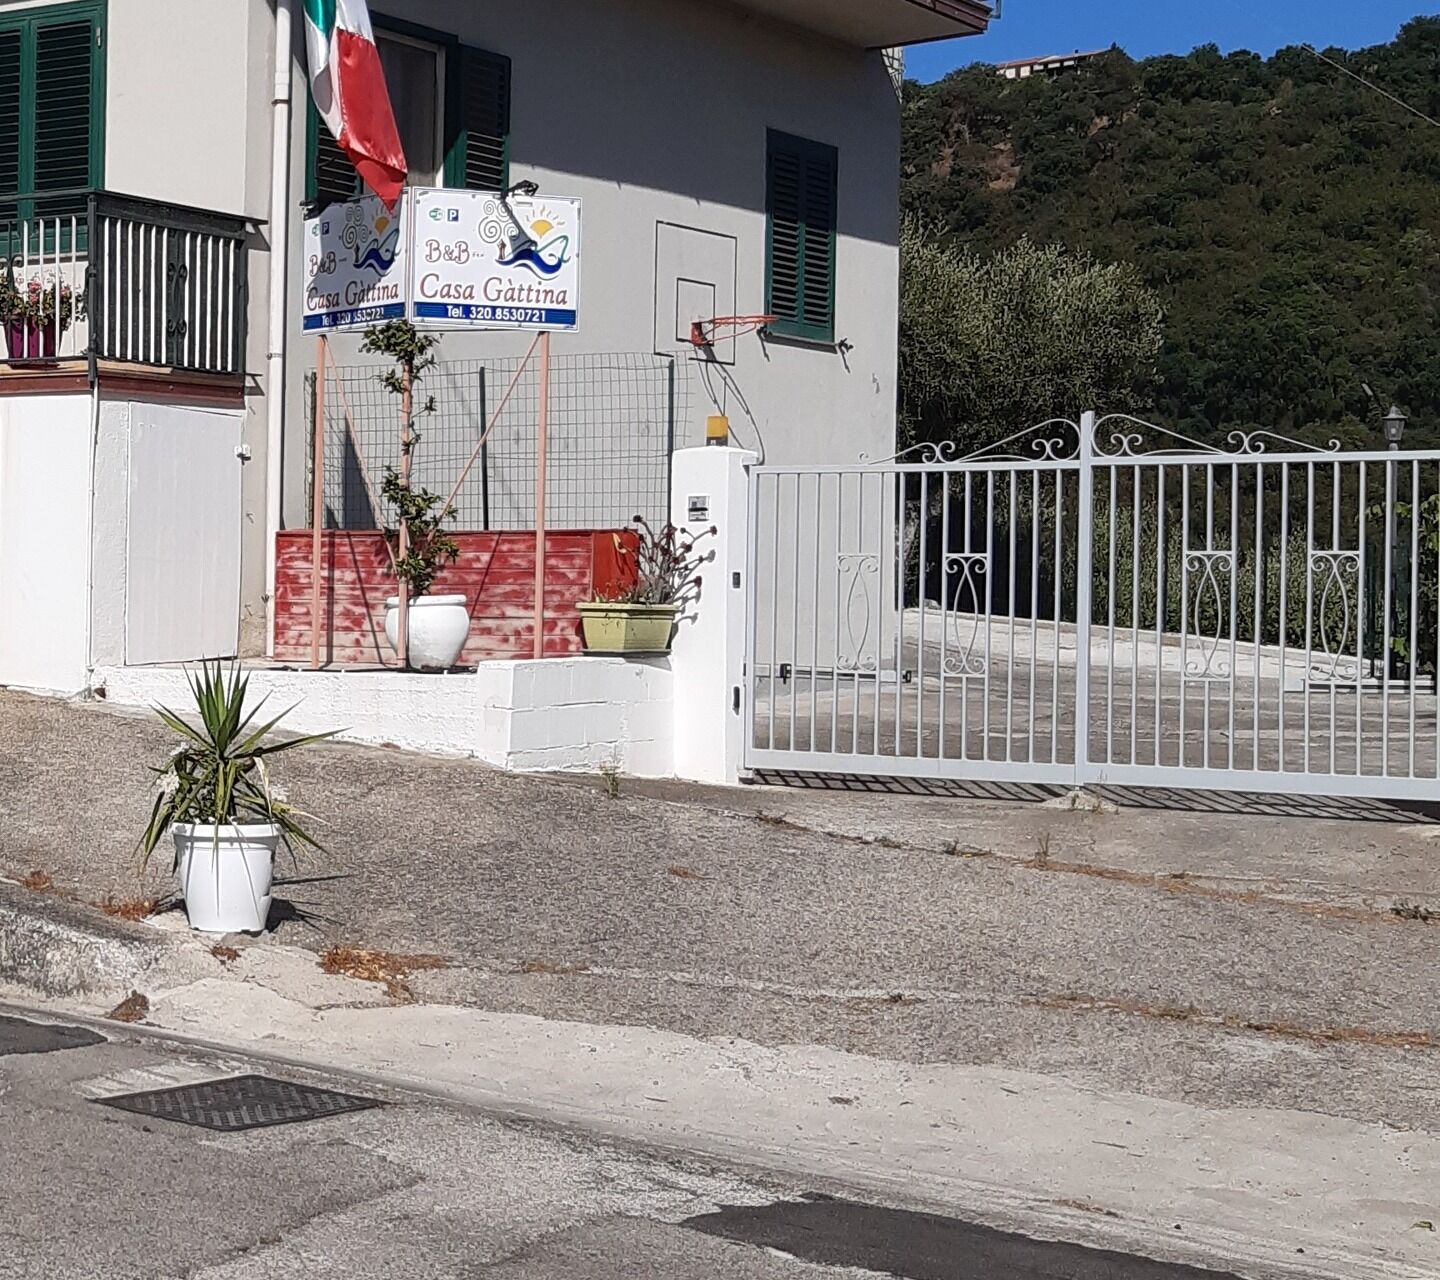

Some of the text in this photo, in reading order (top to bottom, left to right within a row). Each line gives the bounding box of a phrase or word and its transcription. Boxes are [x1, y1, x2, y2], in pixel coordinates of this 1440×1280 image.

[310, 251, 336, 277] B&B
[425, 239, 470, 264] B&B
[307, 279, 398, 311] Casa Gàttina
[420, 273, 568, 305] Casa Gàttina
[446, 305, 547, 322] Tel. 320.8530721
